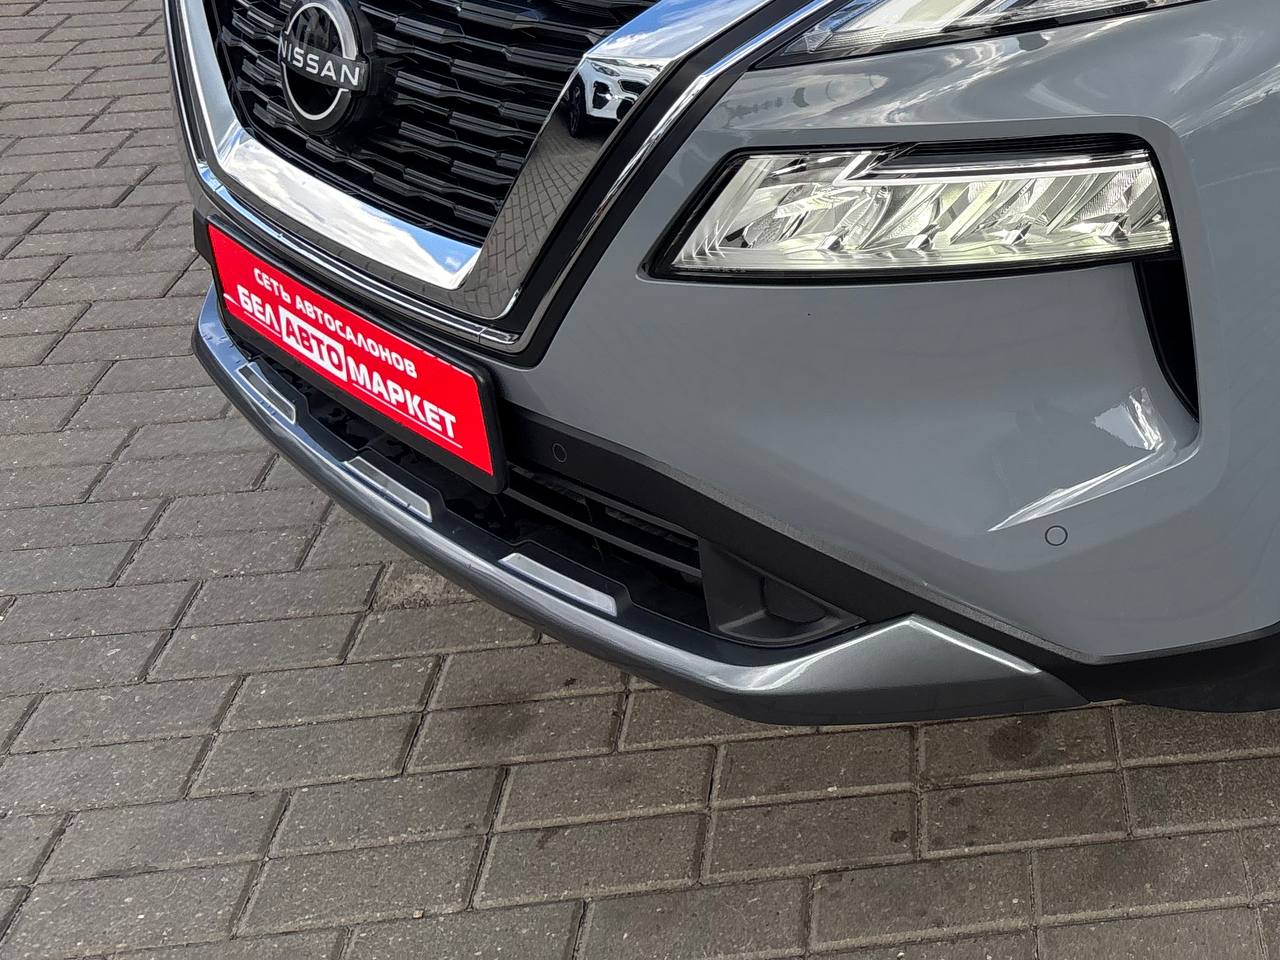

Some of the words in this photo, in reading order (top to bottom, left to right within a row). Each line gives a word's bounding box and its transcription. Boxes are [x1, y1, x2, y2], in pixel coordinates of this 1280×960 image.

[279, 38, 360, 86] NISSAN
[253, 267, 292, 305] СЕТЬ
[295, 291, 418, 379] АВТОСАЛОНОВ
